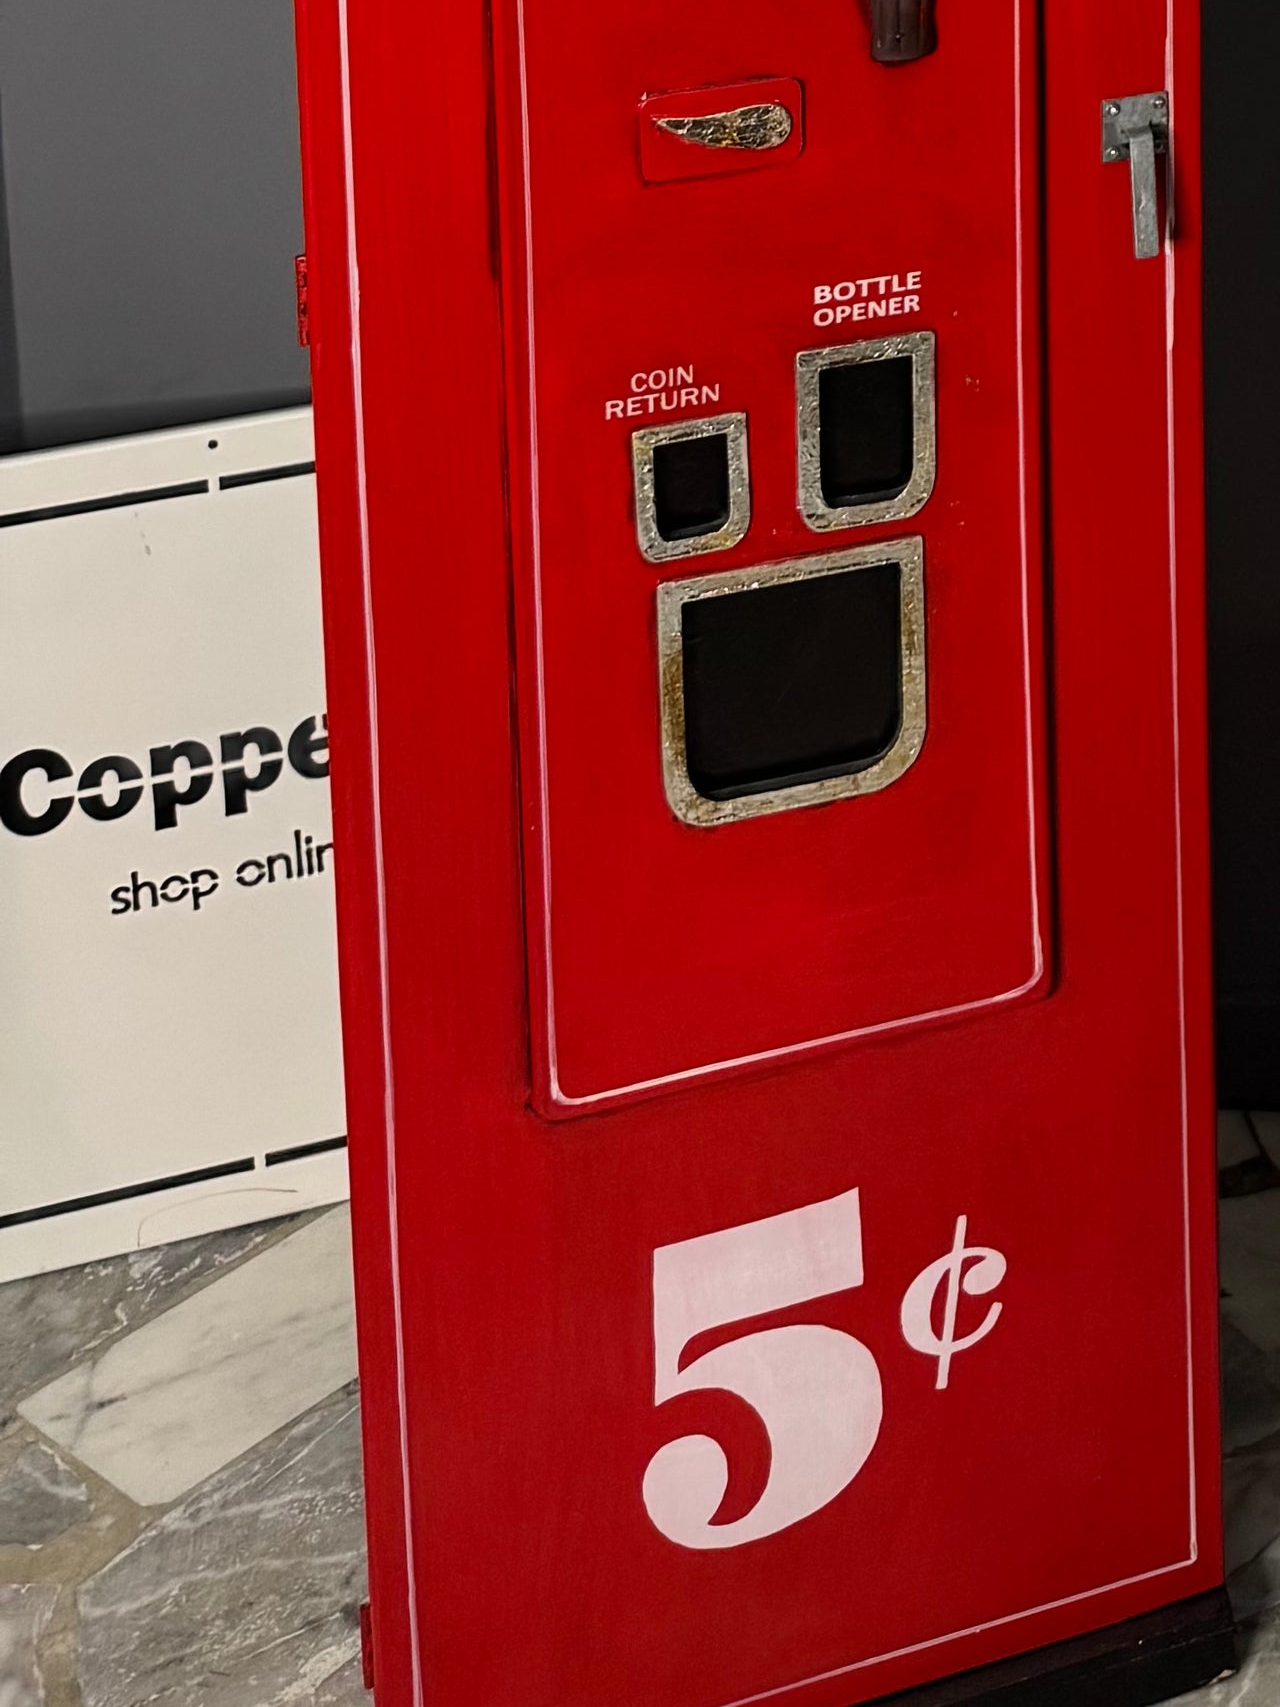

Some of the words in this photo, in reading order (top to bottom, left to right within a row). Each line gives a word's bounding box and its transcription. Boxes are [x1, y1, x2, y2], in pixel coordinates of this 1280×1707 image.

[813, 270, 922, 305] BOTTLE
[813, 294, 920, 327] OPENER
[630, 364, 694, 393] COIN
[605, 383, 720, 421] RETURN
[110, 869, 219, 915] shop
